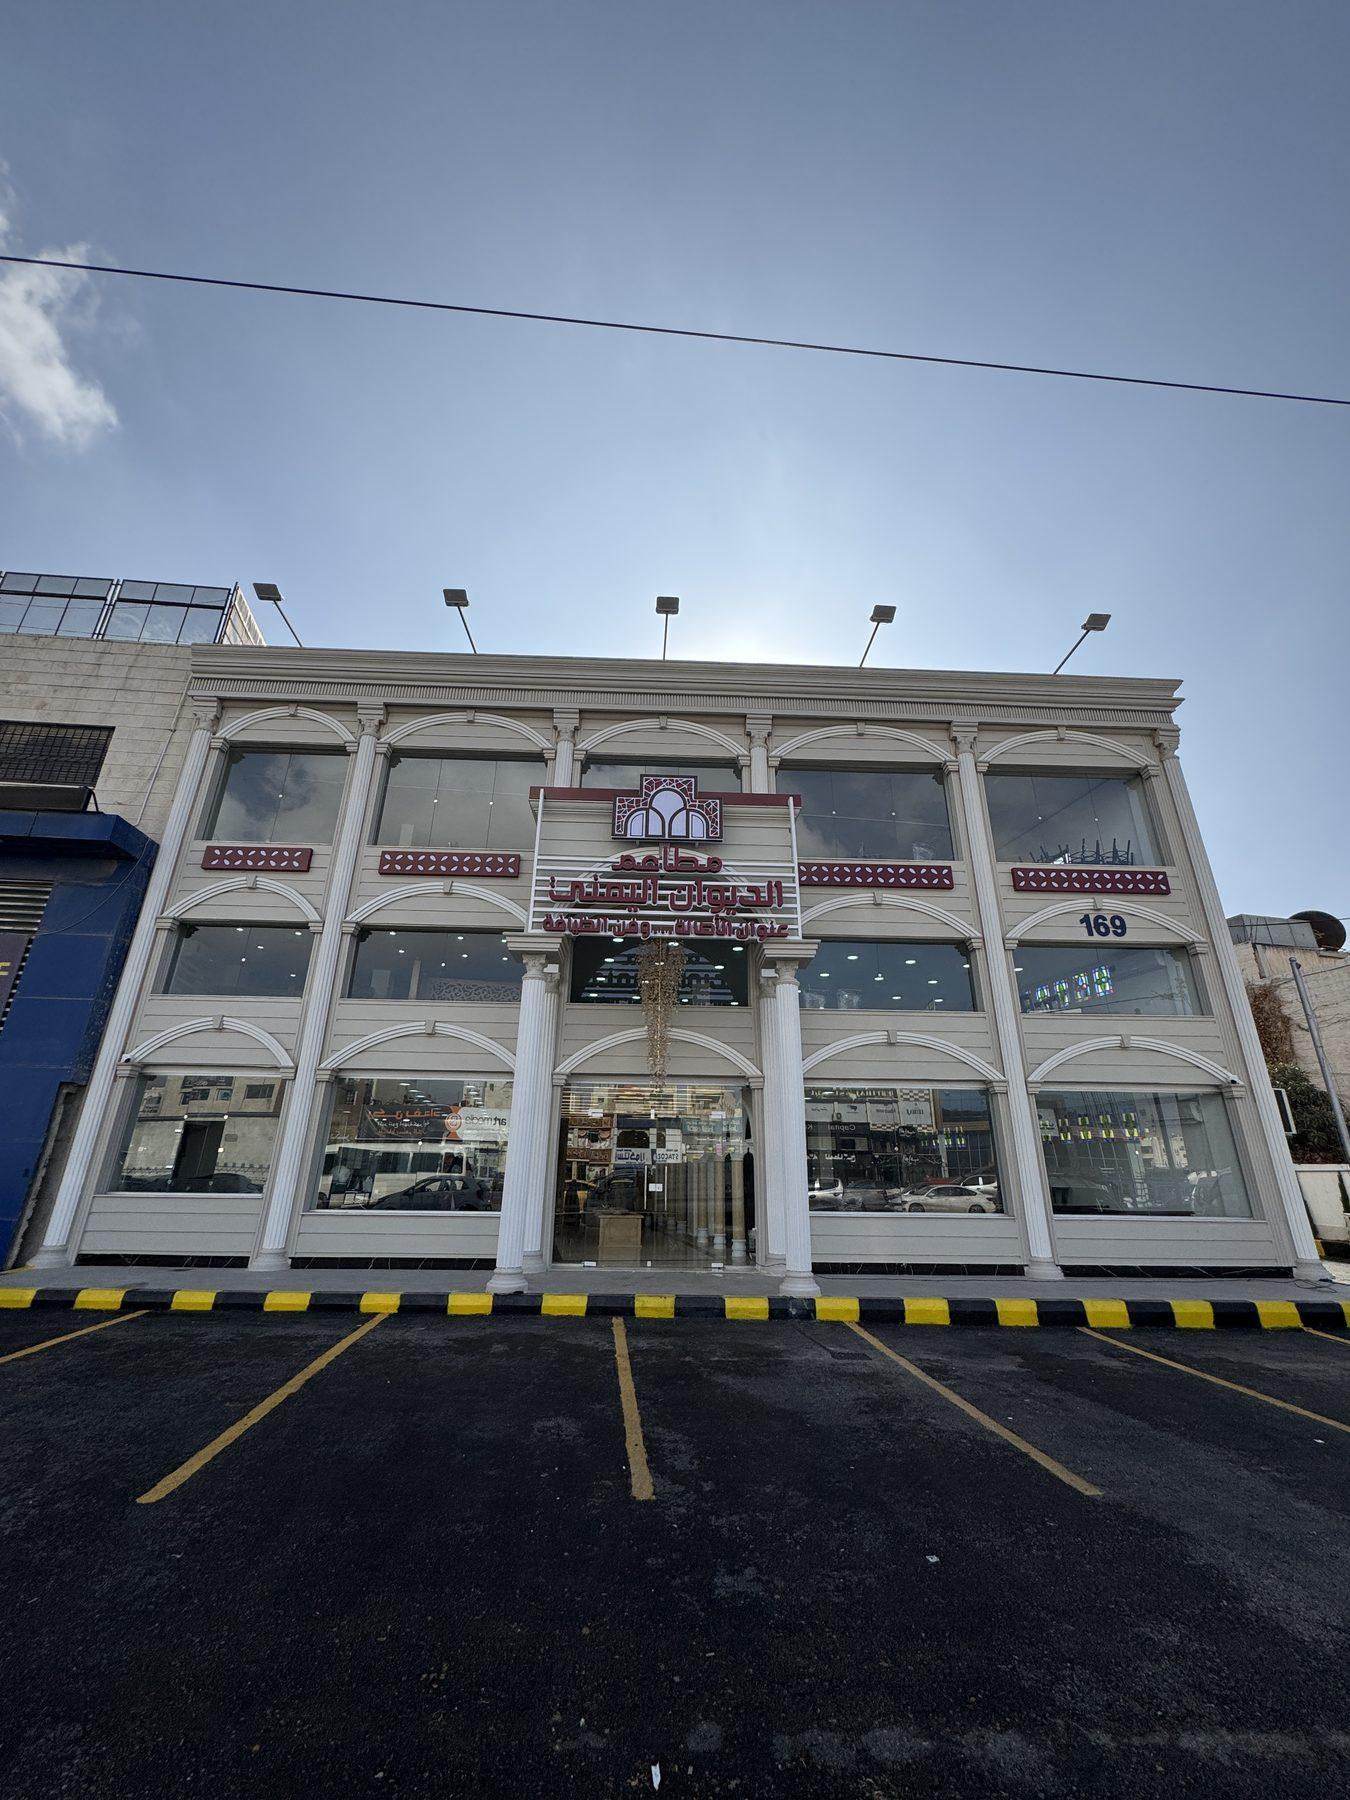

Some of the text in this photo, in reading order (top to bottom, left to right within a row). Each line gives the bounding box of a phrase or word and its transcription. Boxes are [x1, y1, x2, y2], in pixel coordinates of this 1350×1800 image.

[611, 847, 723, 873] مطاعم
[549, 874, 783, 915] الديوان اليمني
[542, 913, 608, 937] الضيافة
[736, 919, 790, 941] عنوان
[1079, 913, 1127, 937] 169
